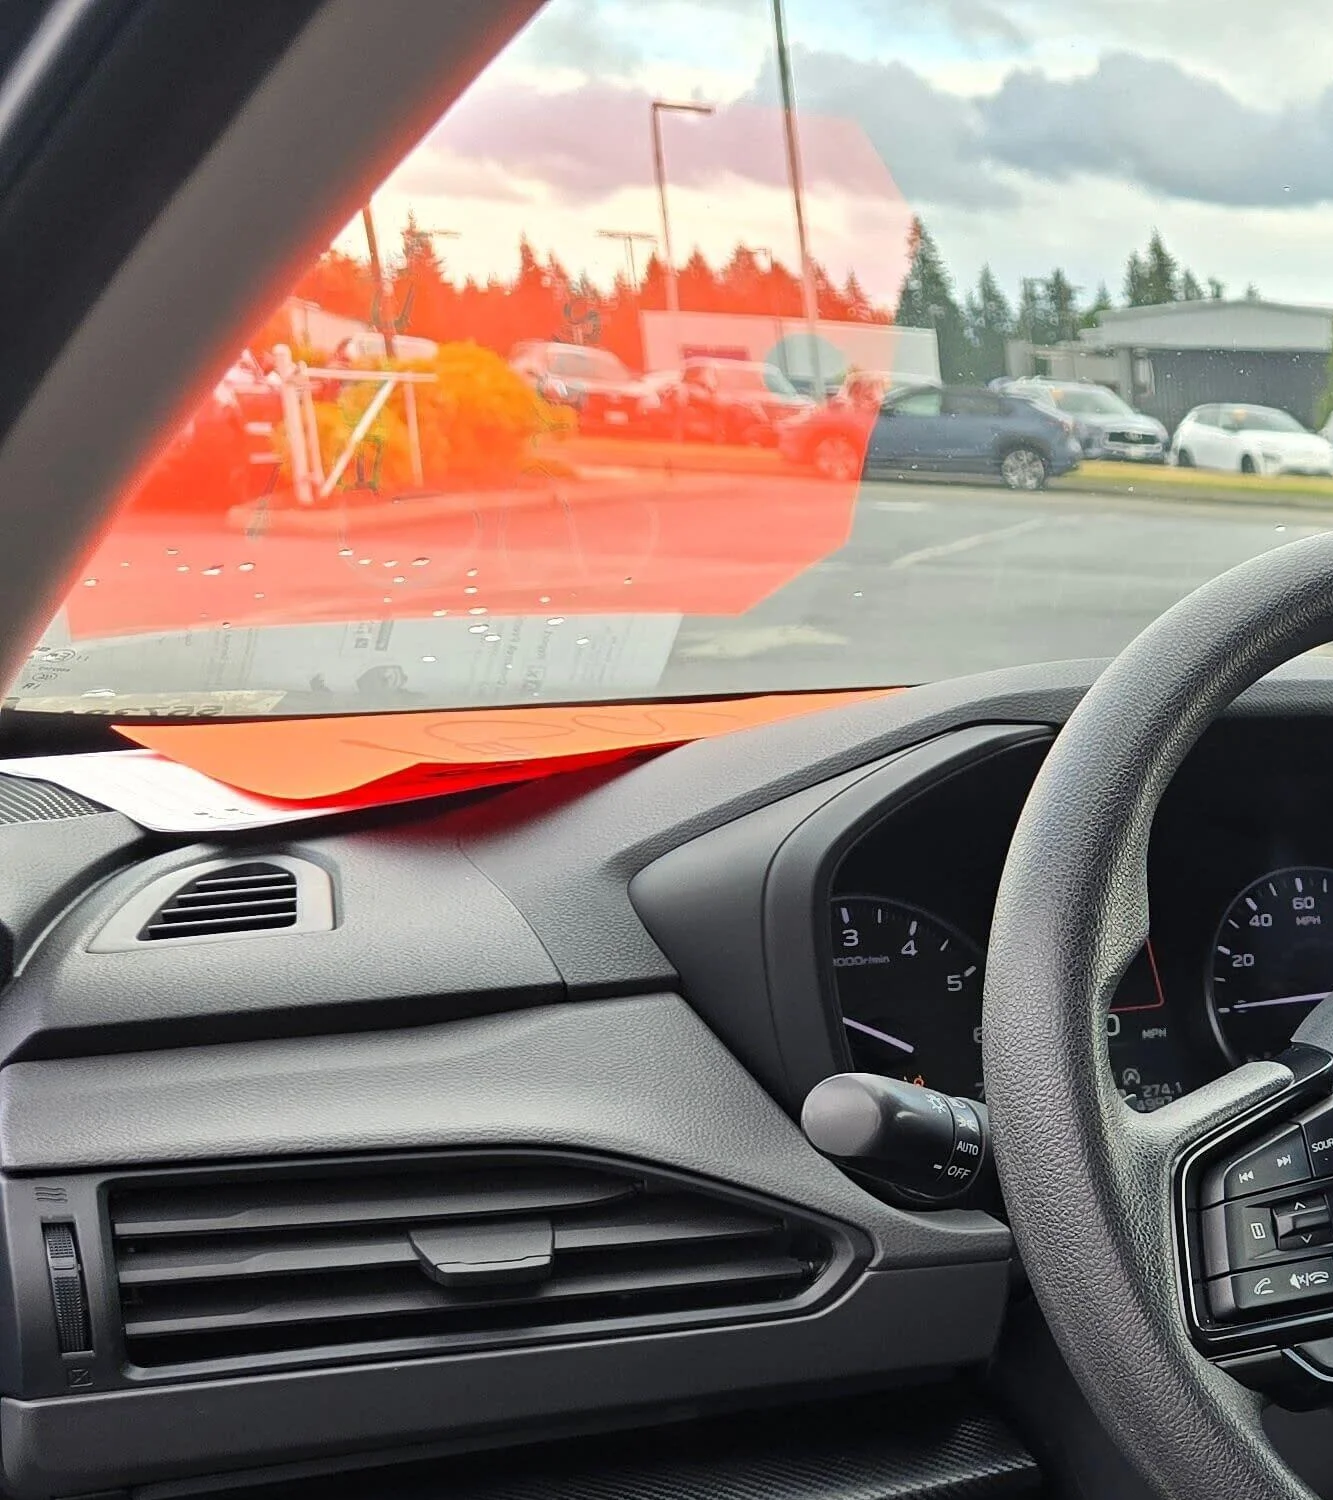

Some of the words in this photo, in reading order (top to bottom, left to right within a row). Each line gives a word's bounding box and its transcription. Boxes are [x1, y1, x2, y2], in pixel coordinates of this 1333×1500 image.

[1292, 896, 1315, 910] 60
[1249, 913, 1273, 927] 40
[842, 929, 859, 947] 3
[901, 939, 919, 957] 4
[1231, 953, 1256, 968] 20
[946, 973, 963, 992] 5
[956, 1140, 979, 1156] AUTO
[947, 1165, 972, 1179] OFF
